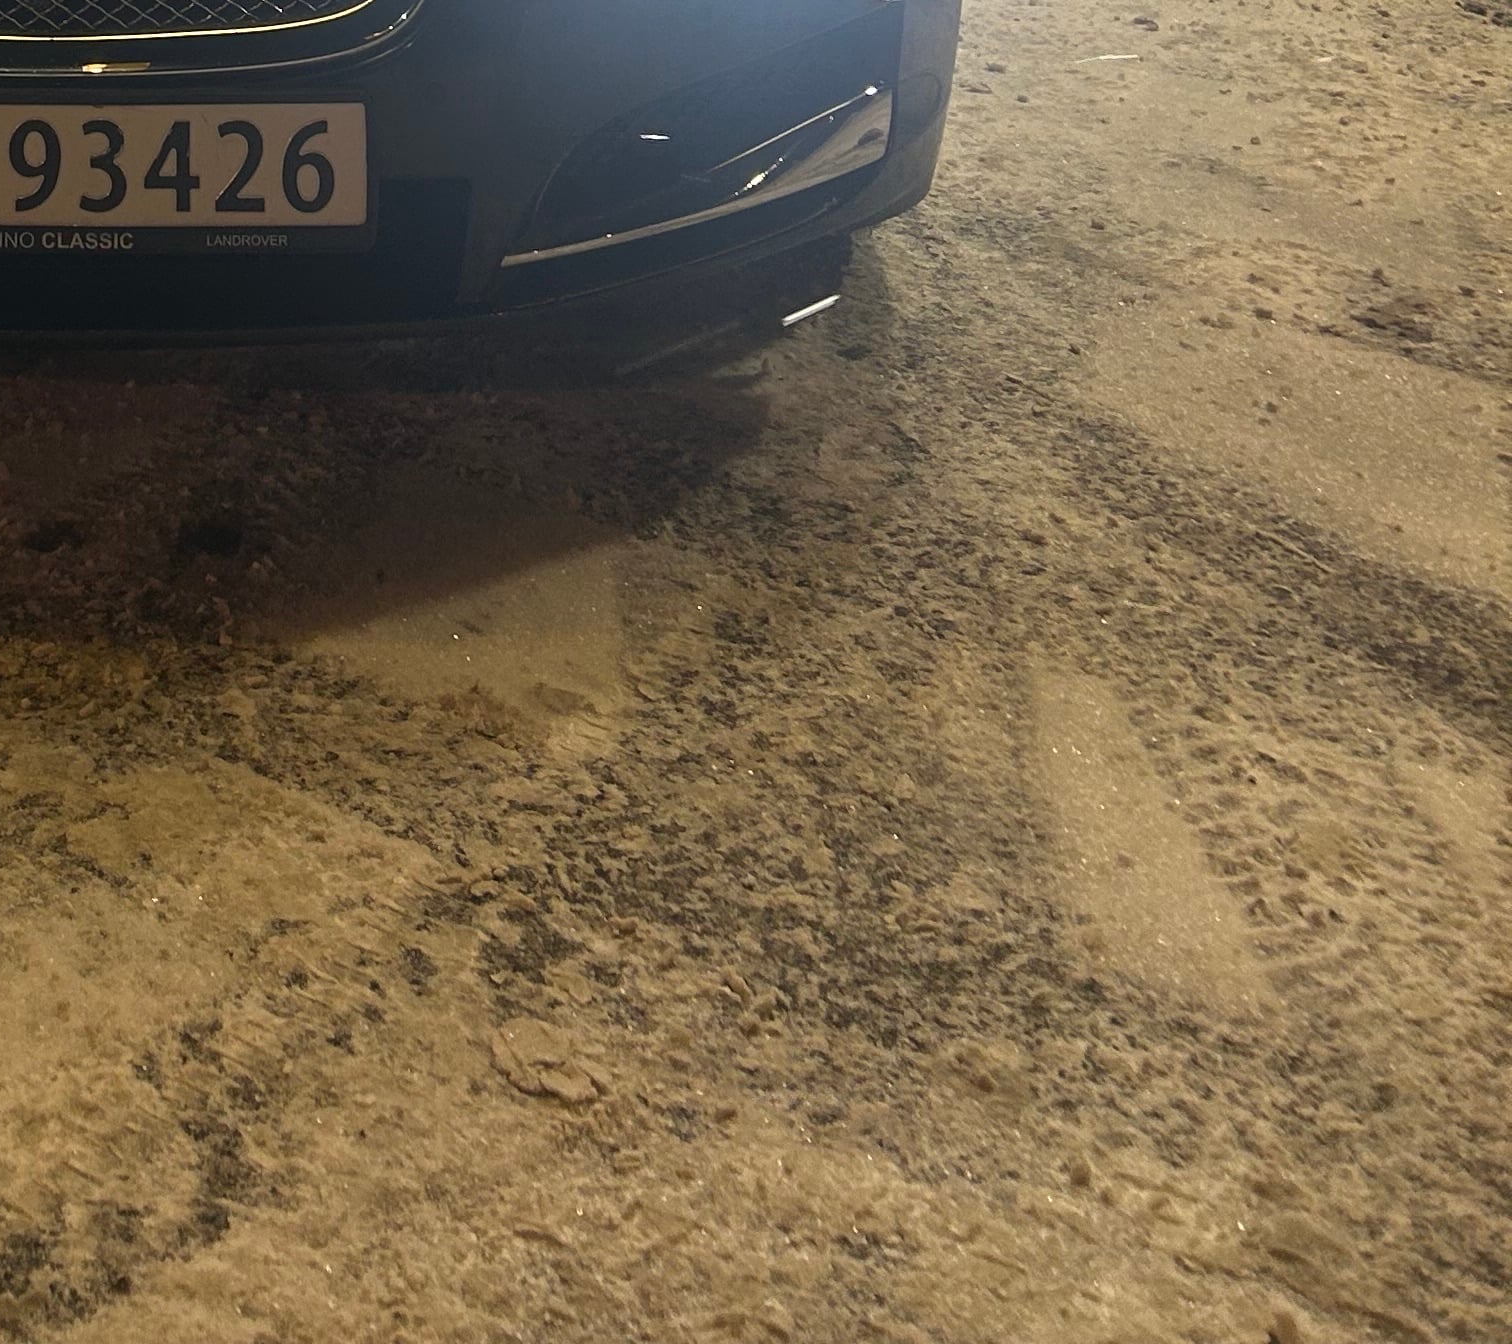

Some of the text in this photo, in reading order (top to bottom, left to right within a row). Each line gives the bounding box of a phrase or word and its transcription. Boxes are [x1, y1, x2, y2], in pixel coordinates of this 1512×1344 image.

[8, 119, 336, 214] 93426
[41, 231, 135, 250] CLASSIC
[206, 234, 289, 248] LANDROVER
